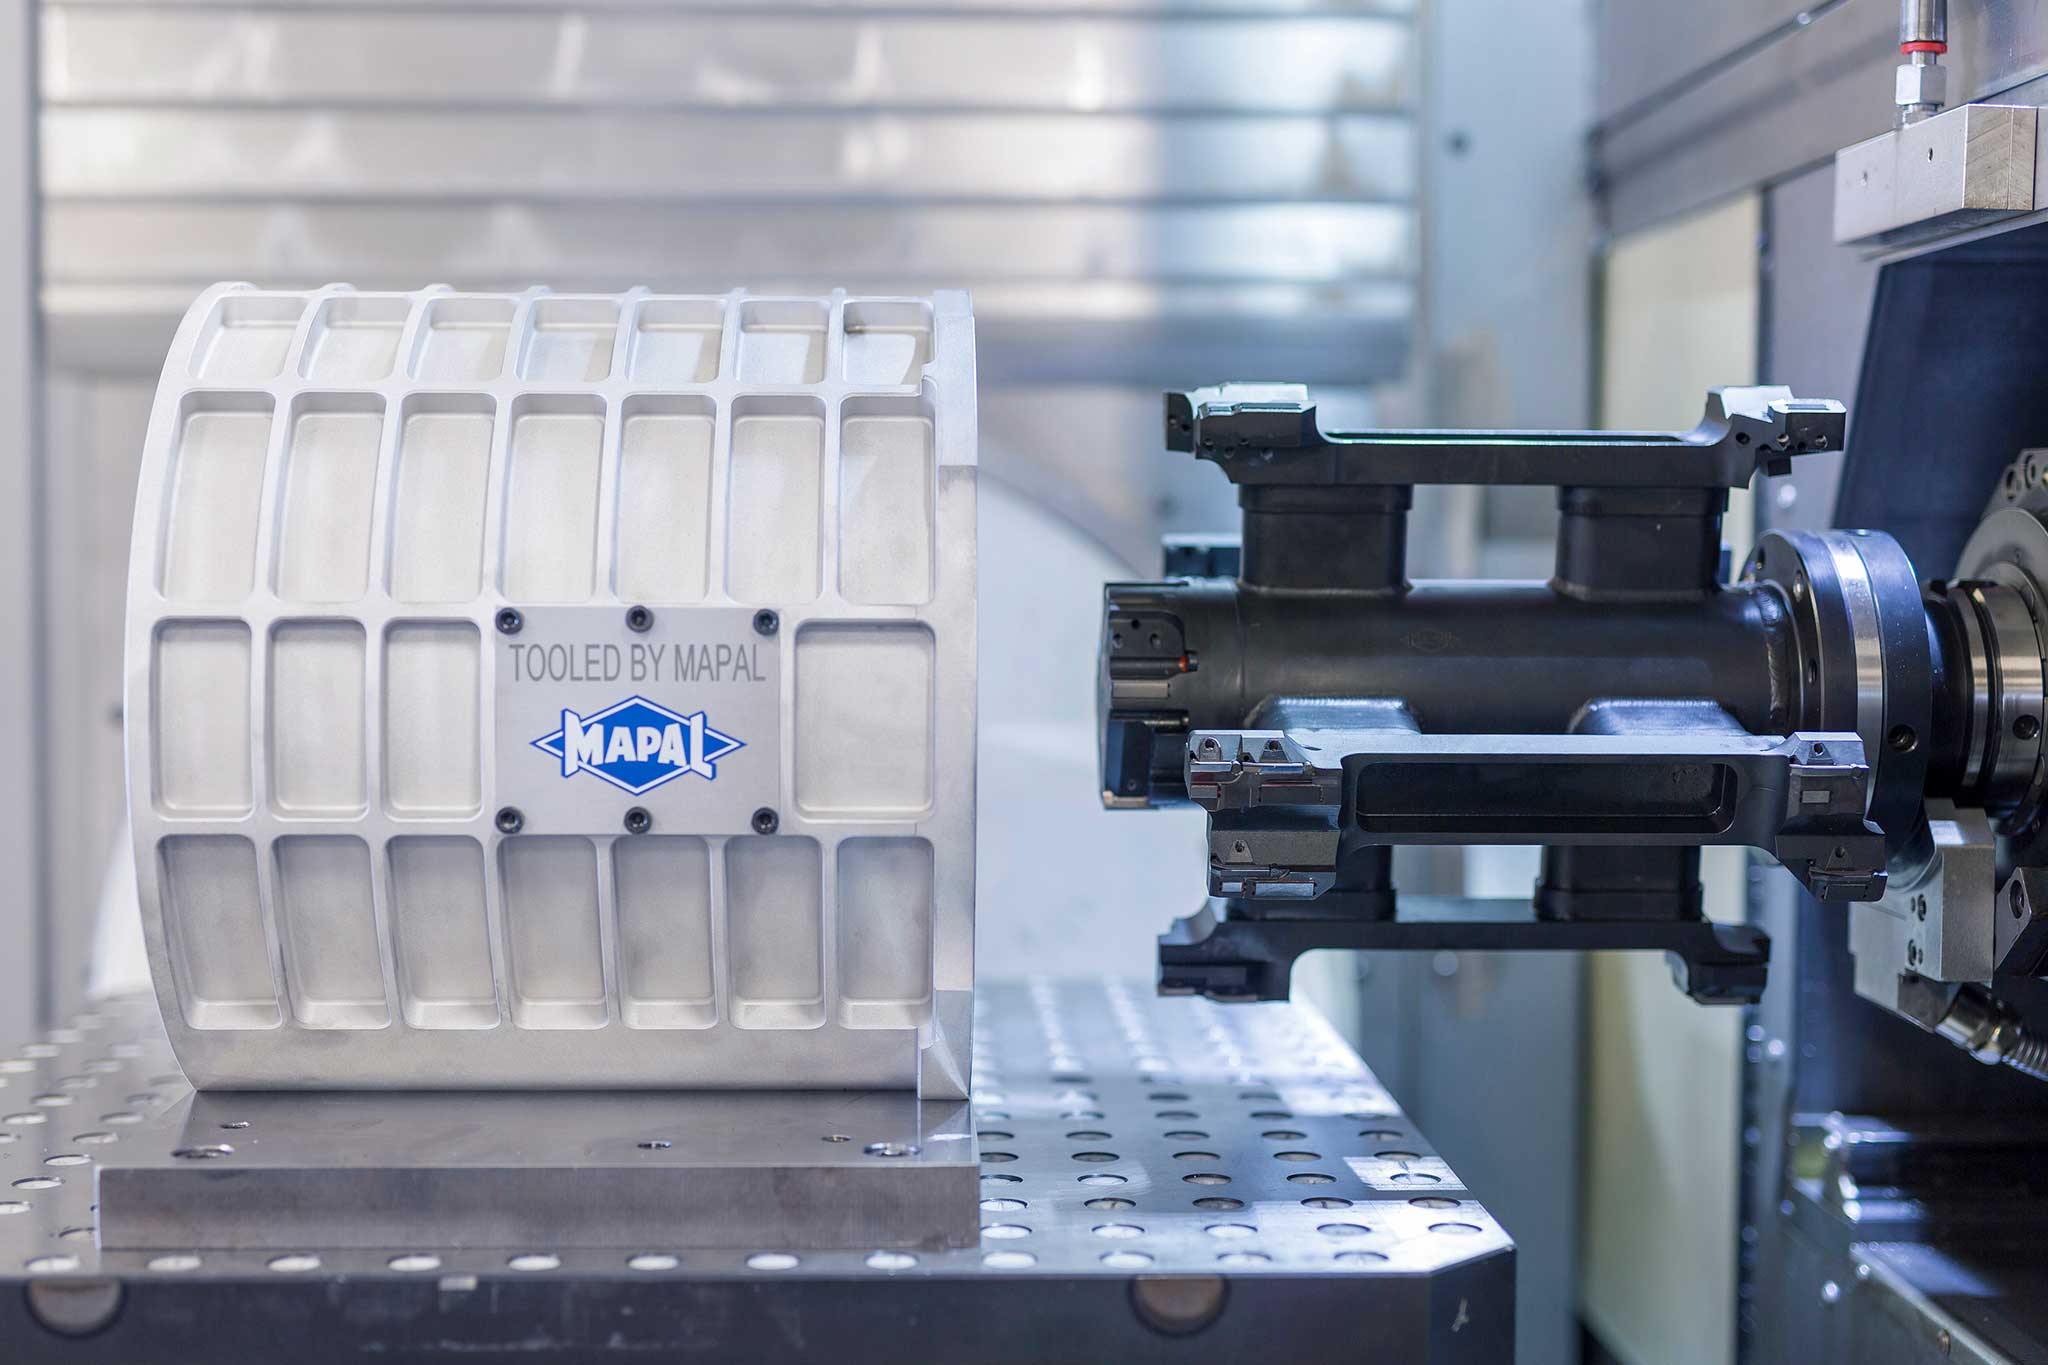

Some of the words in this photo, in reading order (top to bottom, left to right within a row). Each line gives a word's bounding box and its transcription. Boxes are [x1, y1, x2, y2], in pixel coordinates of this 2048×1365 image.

[509, 644, 621, 682] TOOLED
[631, 644, 665, 681] BY
[674, 644, 766, 681] MAPAL
[562, 708, 716, 780] MAPAL
